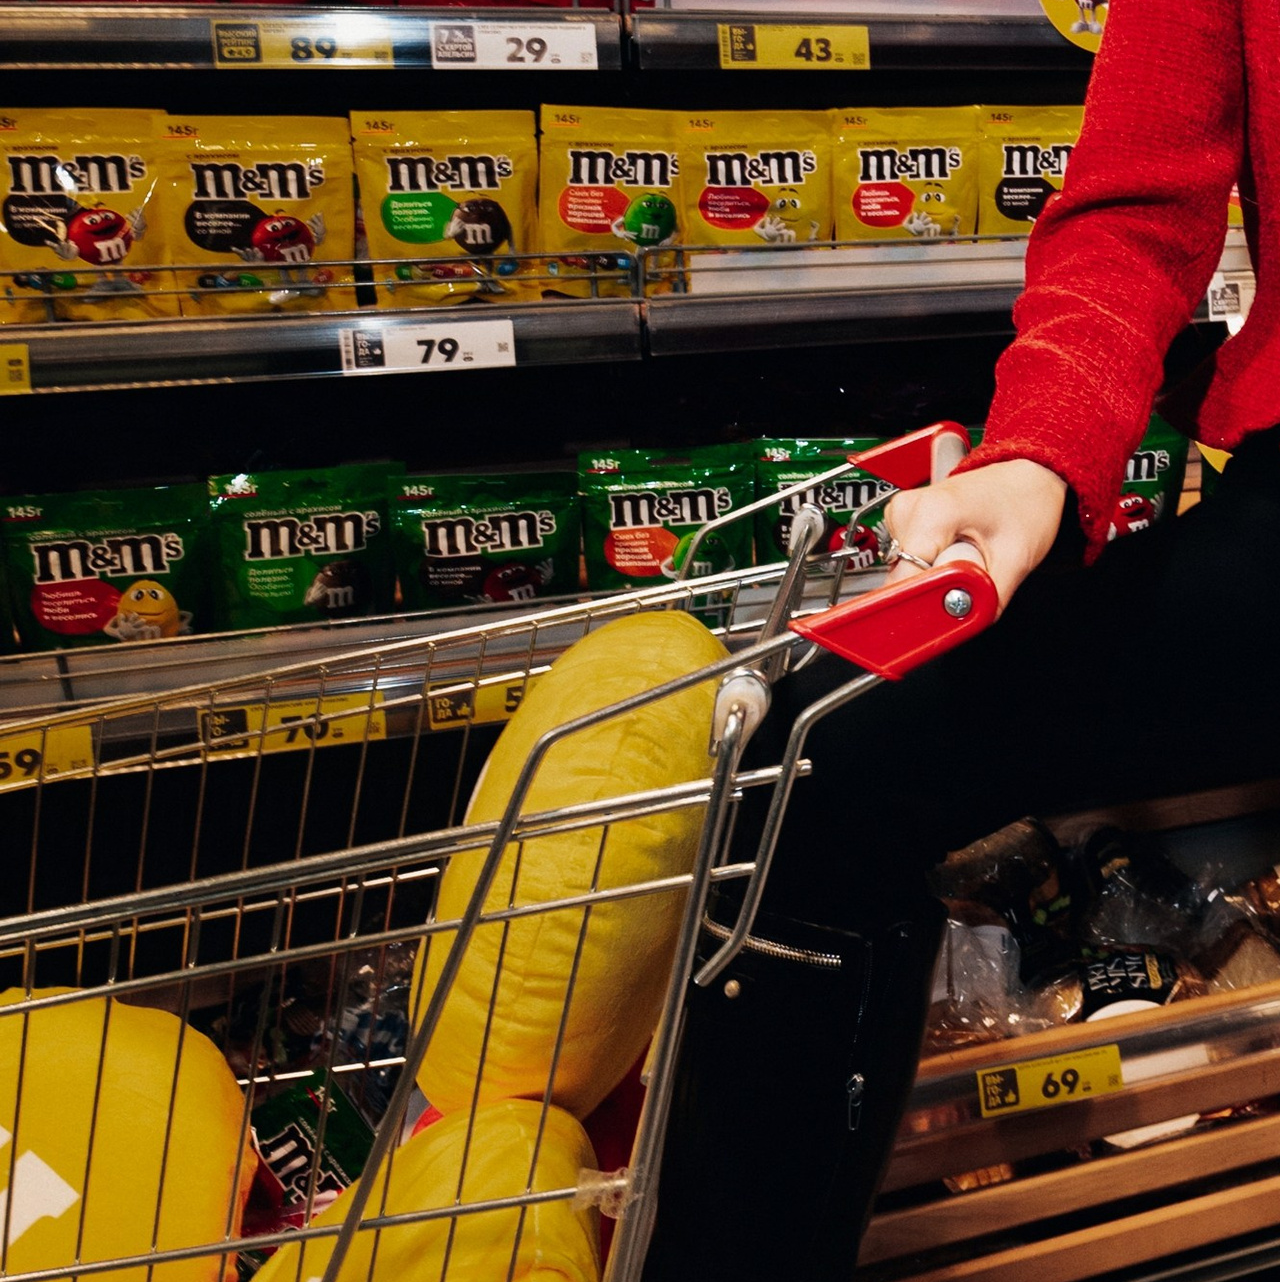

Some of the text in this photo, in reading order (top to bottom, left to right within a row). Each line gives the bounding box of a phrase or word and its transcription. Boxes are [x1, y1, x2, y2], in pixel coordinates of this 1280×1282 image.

[291, 36, 338, 63] 89
[506, 37, 548, 63] 29
[794, 38, 832, 62] 43
[189, 157, 326, 201] m&m's
[386, 154, 513, 193] m&m's
[704, 148, 817, 188] m&m's
[858, 145, 963, 183] m&m's
[417, 337, 460, 364] 79
[609, 487, 732, 532] m&m's
[244, 510, 381, 561] m&m's
[420, 510, 556, 558] m&m's
[29, 533, 185, 585] m&m's
[1042, 1068, 1080, 1099] 69
